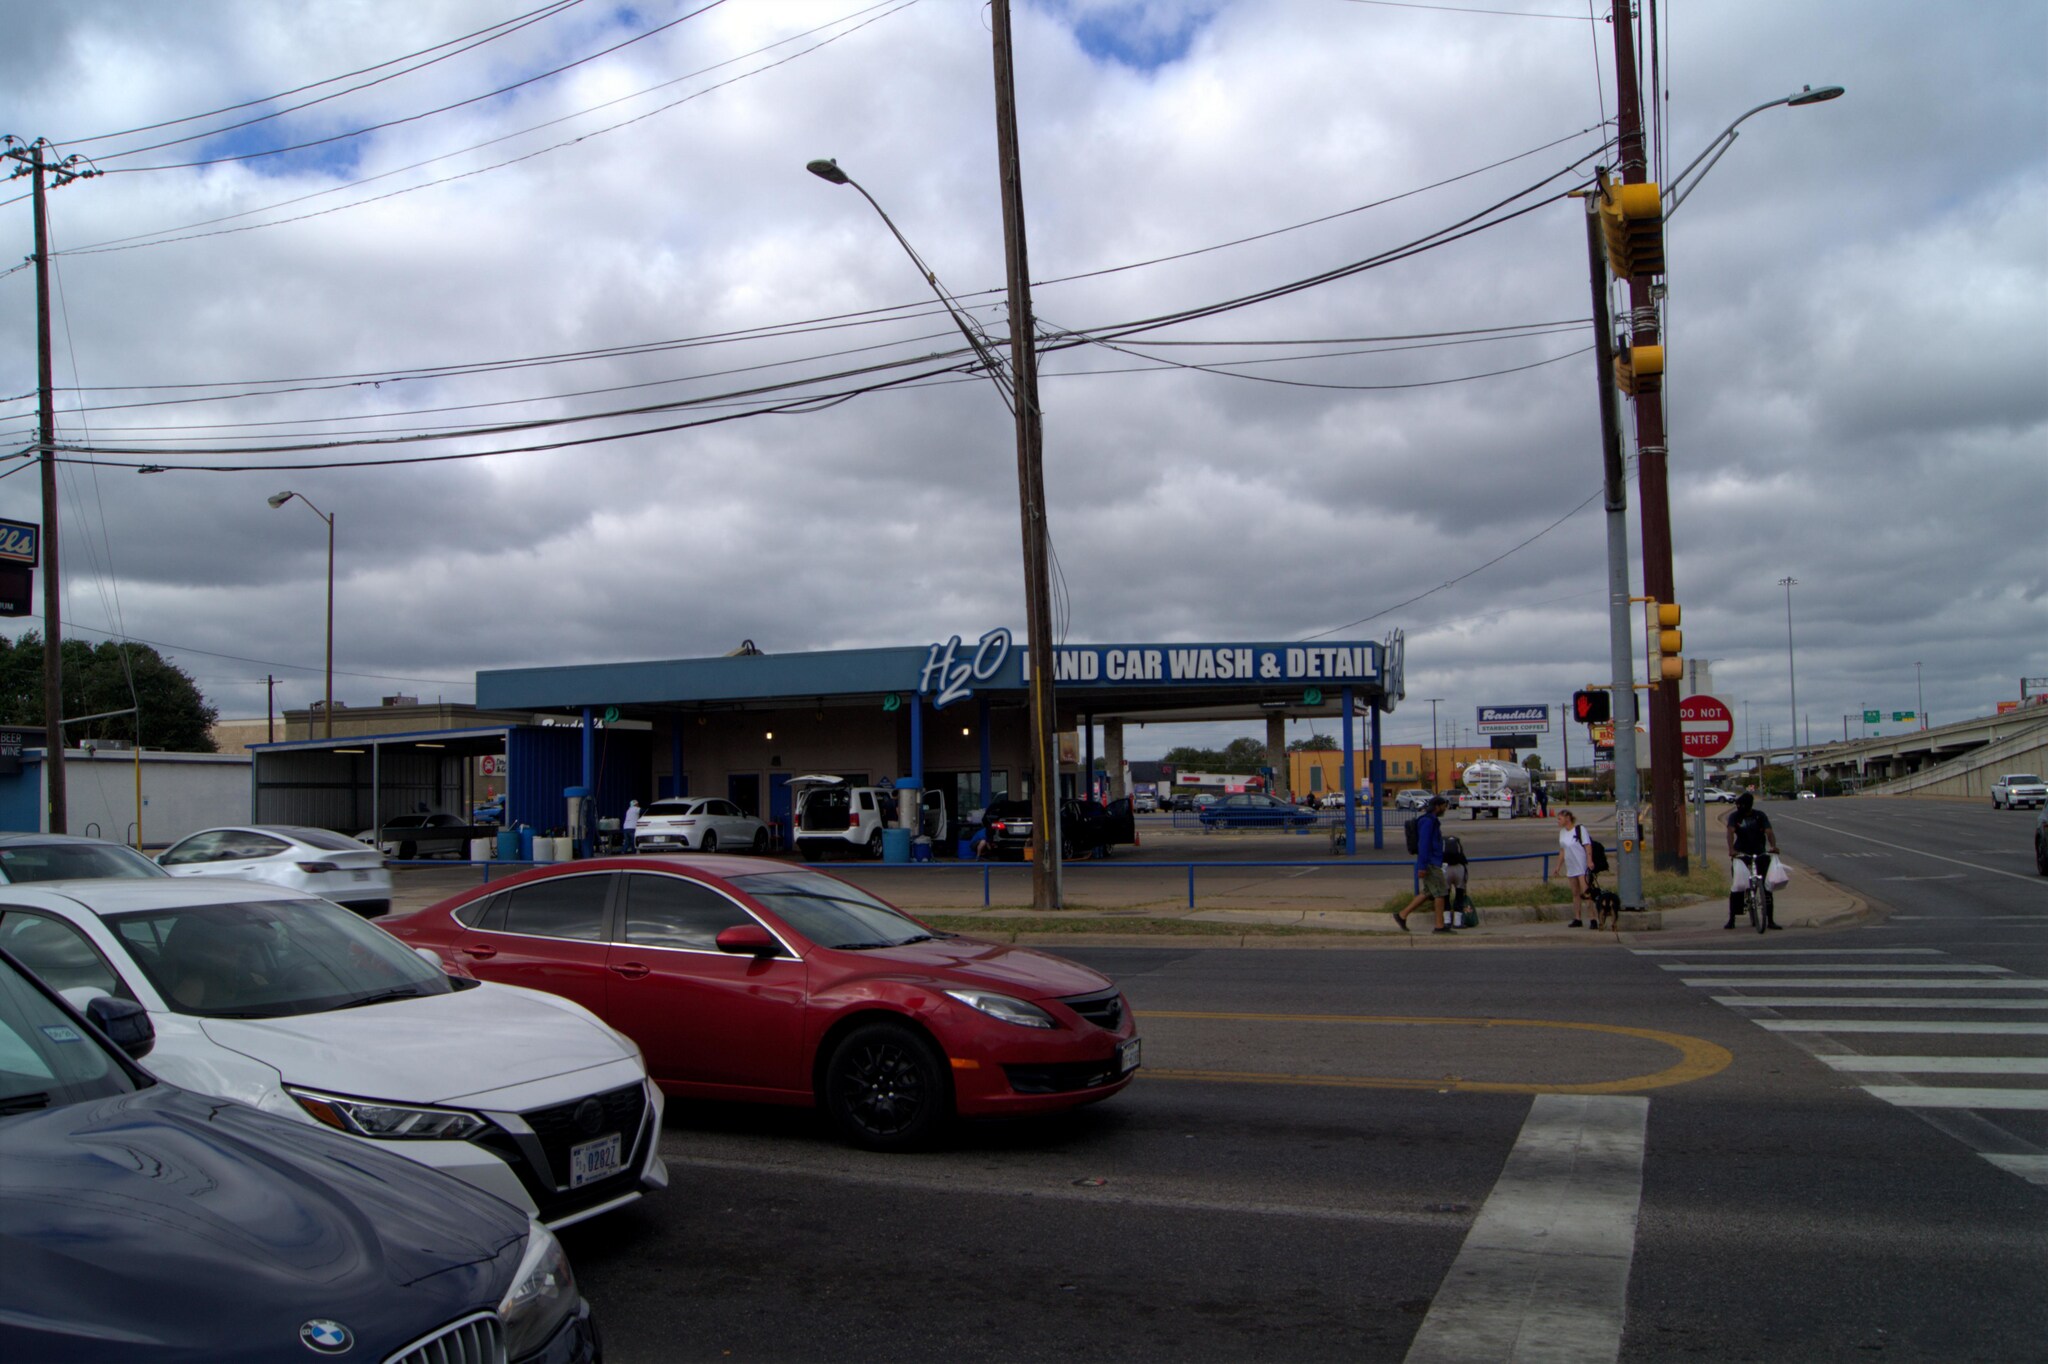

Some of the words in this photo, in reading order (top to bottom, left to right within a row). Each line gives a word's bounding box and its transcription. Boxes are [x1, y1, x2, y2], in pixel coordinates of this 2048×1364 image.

[919, 628, 1010, 707] H2O
[1106, 649, 1163, 680] CAR
[1168, 648, 1253, 679] WASH
[1260, 652, 1282, 679] &
[1286, 647, 1378, 678] DETAIL
[1482, 709, 1545, 721] Randalls
[1680, 708, 1695, 718] DO
[1700, 708, 1722, 718] NOT
[0, 732, 22, 743] BEER
[1684, 734, 1719, 745] ENTER
[0, 746, 21, 757] WINE
